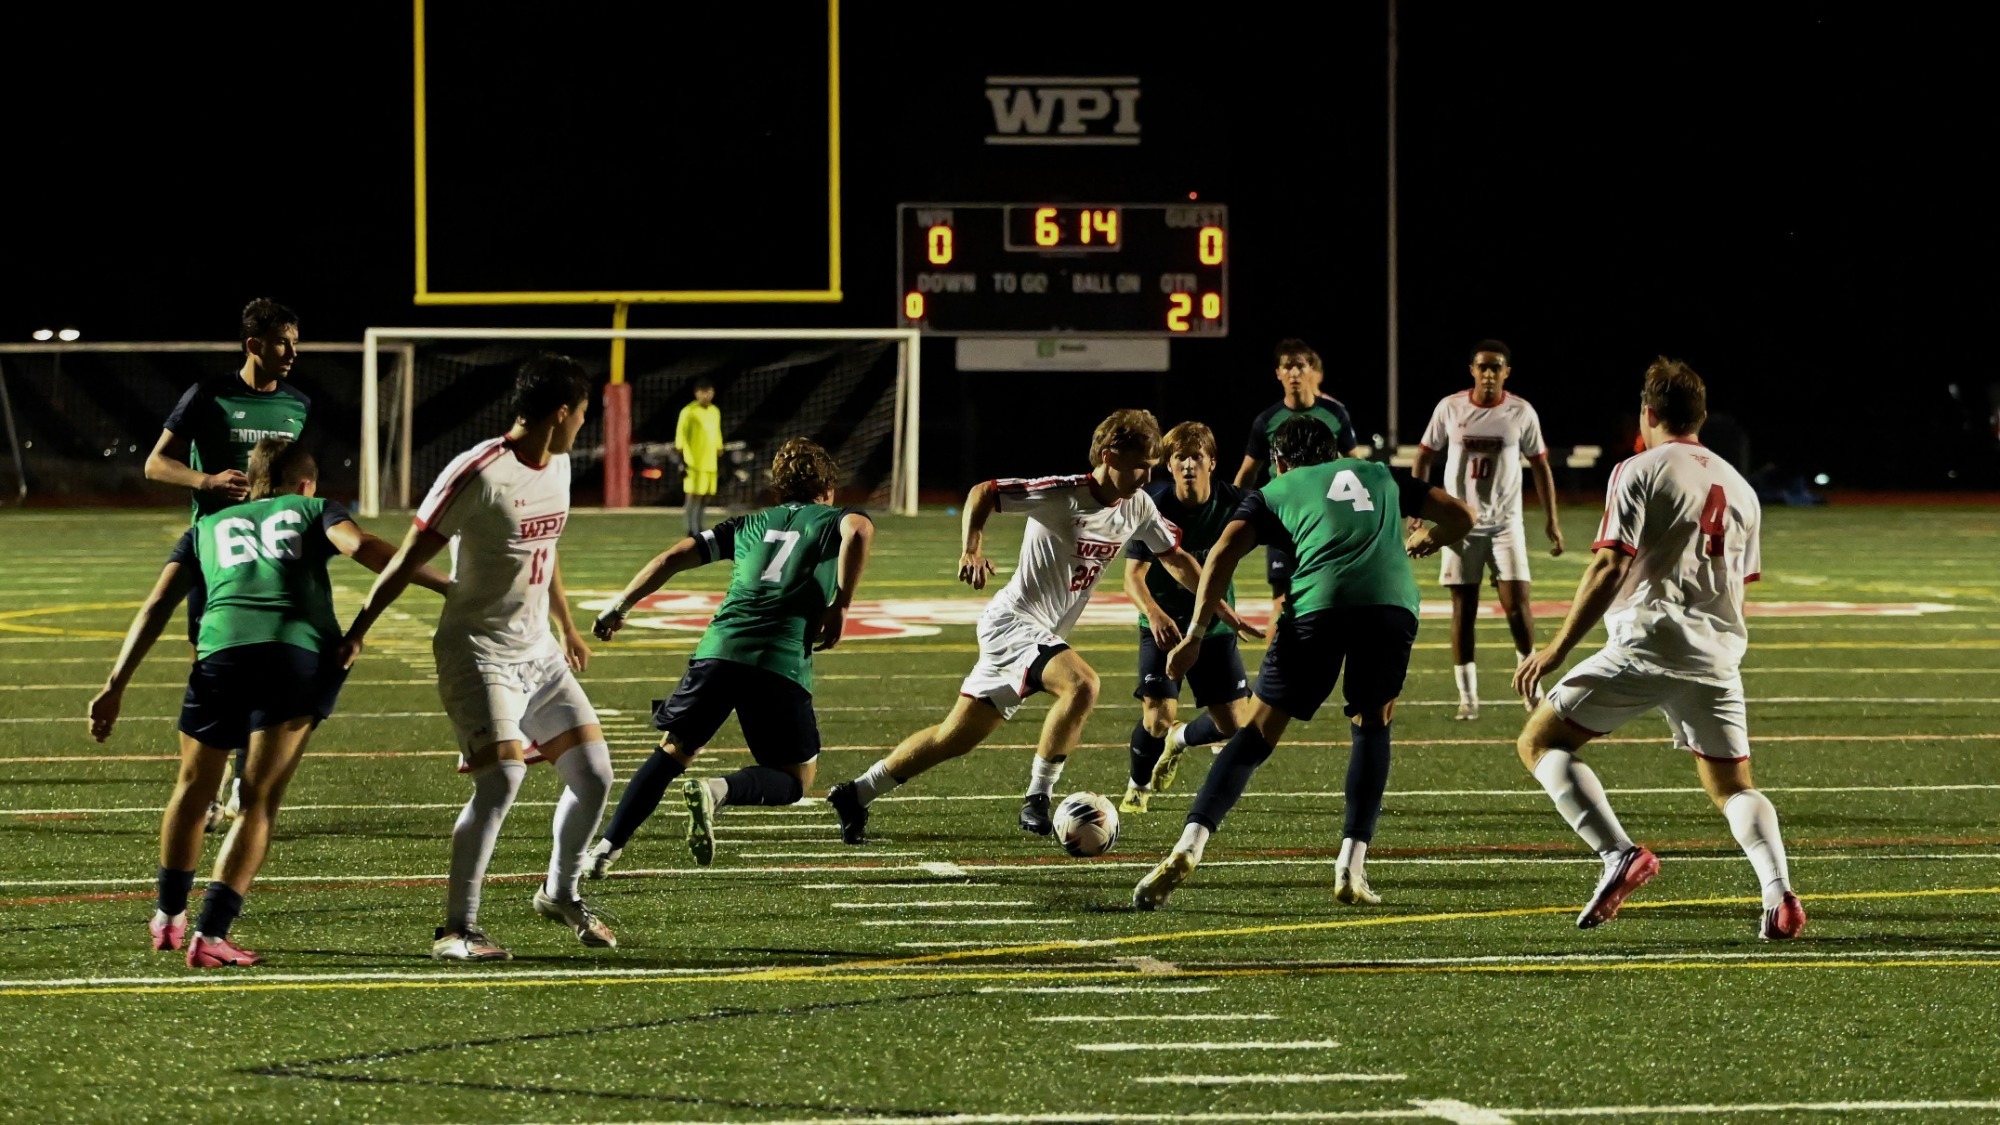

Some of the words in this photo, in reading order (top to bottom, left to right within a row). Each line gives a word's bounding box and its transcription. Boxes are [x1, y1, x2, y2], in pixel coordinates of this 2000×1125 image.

[985, 88, 1142, 134] WPI
[928, 225, 953, 265] 0
[1199, 226, 1224, 266] 0
[917, 272, 976, 294] DOWN
[992, 272, 1018, 294] TO
[1020, 272, 1048, 294] GO
[905, 292, 924, 318] 0
[1166, 292, 1192, 332] 2
[1201, 292, 1221, 319] 0
[1471, 457, 1492, 479] 10
[1326, 469, 1375, 512] 4
[521, 516, 565, 540] WPI
[1699, 483, 1727, 556] 4
[214, 509, 302, 568] 66
[760, 529, 800, 583] 7
[1077, 541, 1120, 559] WPI
[529, 548, 547, 585] 11
[1069, 564, 1100, 592] 26
